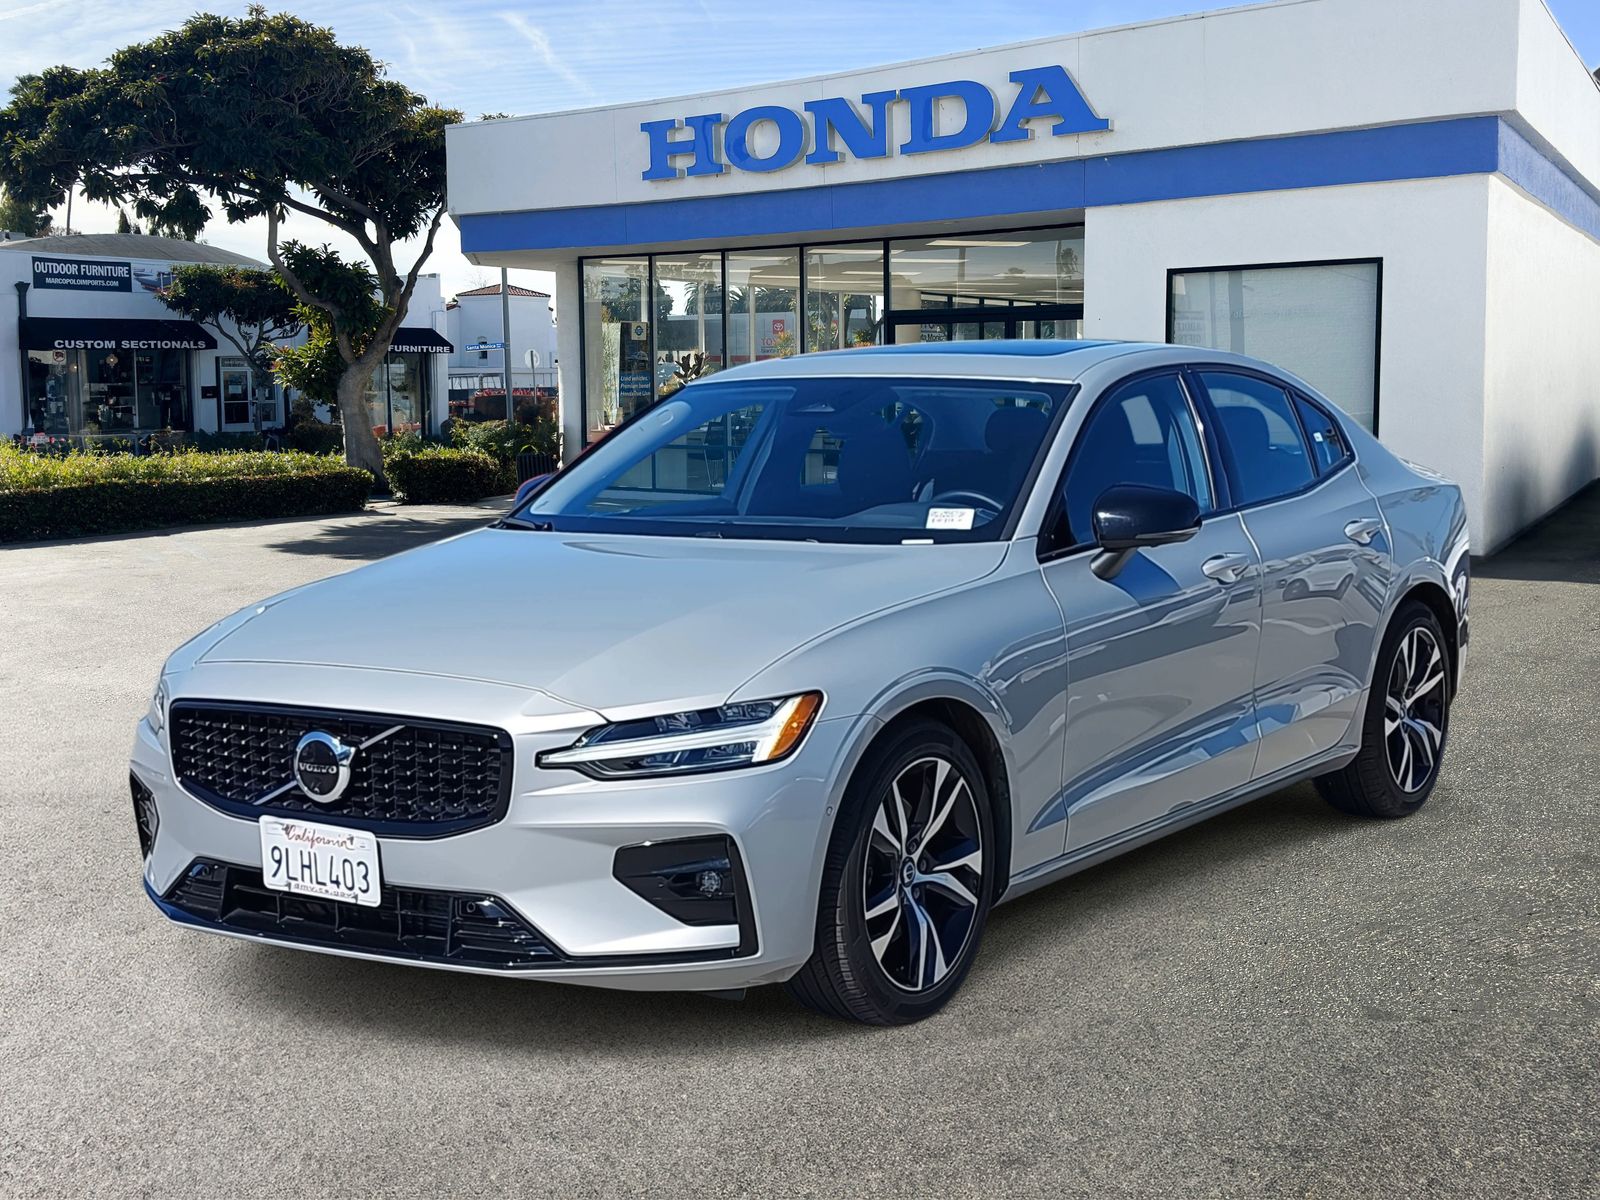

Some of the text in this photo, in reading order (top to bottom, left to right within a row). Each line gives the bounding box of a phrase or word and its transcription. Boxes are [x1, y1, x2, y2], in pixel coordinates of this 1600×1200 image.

[640, 65, 1110, 181] HONDA
[34, 261, 129, 278] OUTDOOR FURNITURE
[45, 277, 119, 287] MARCOPOLOIMPORTS.COM
[54, 339, 206, 349] CUSTOM SECTIONALS
[388, 344, 450, 353] FURNITURE
[299, 763, 337, 774] VOLVO
[284, 825, 355, 850] California
[271, 846, 370, 894] 9LHL403
